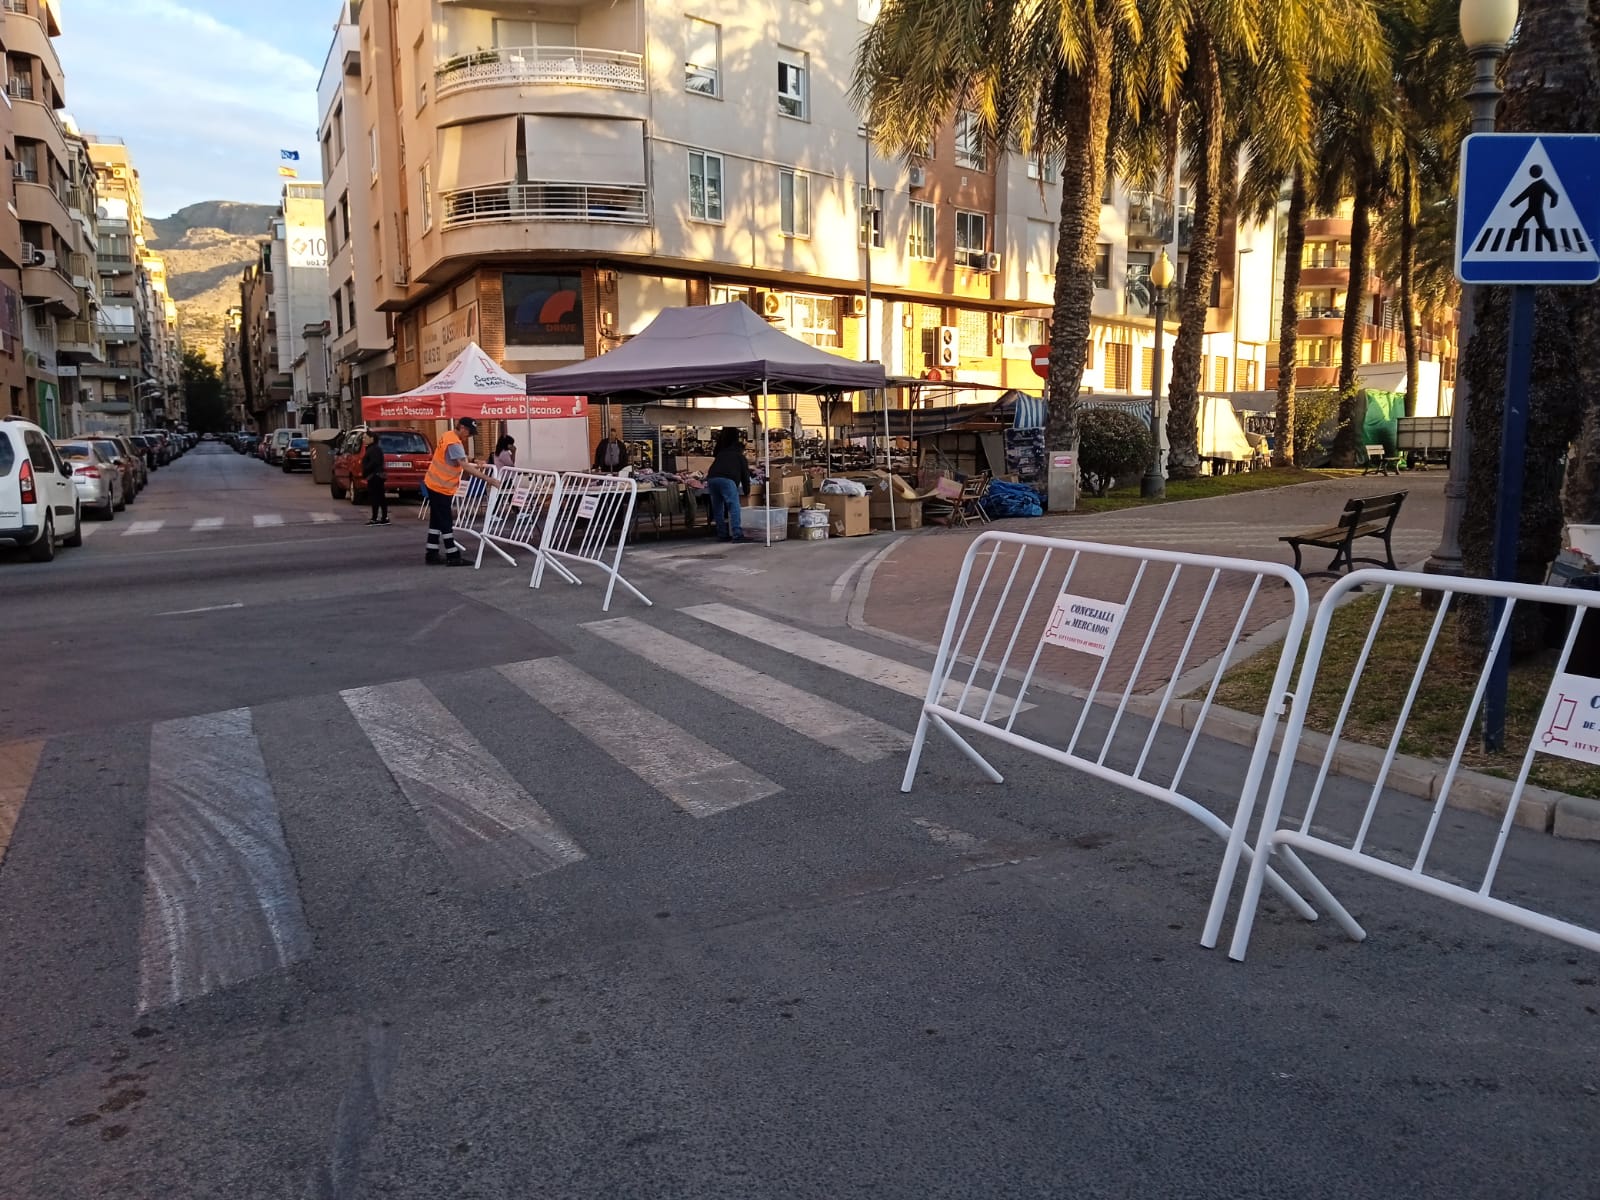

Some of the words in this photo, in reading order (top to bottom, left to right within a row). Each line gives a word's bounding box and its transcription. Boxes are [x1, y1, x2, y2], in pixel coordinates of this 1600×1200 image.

[481, 402, 503, 415] Área
[505, 405, 518, 414] de
[1071, 618, 1110, 636] MERCADOS
[1582, 720, 1596, 730] DE
